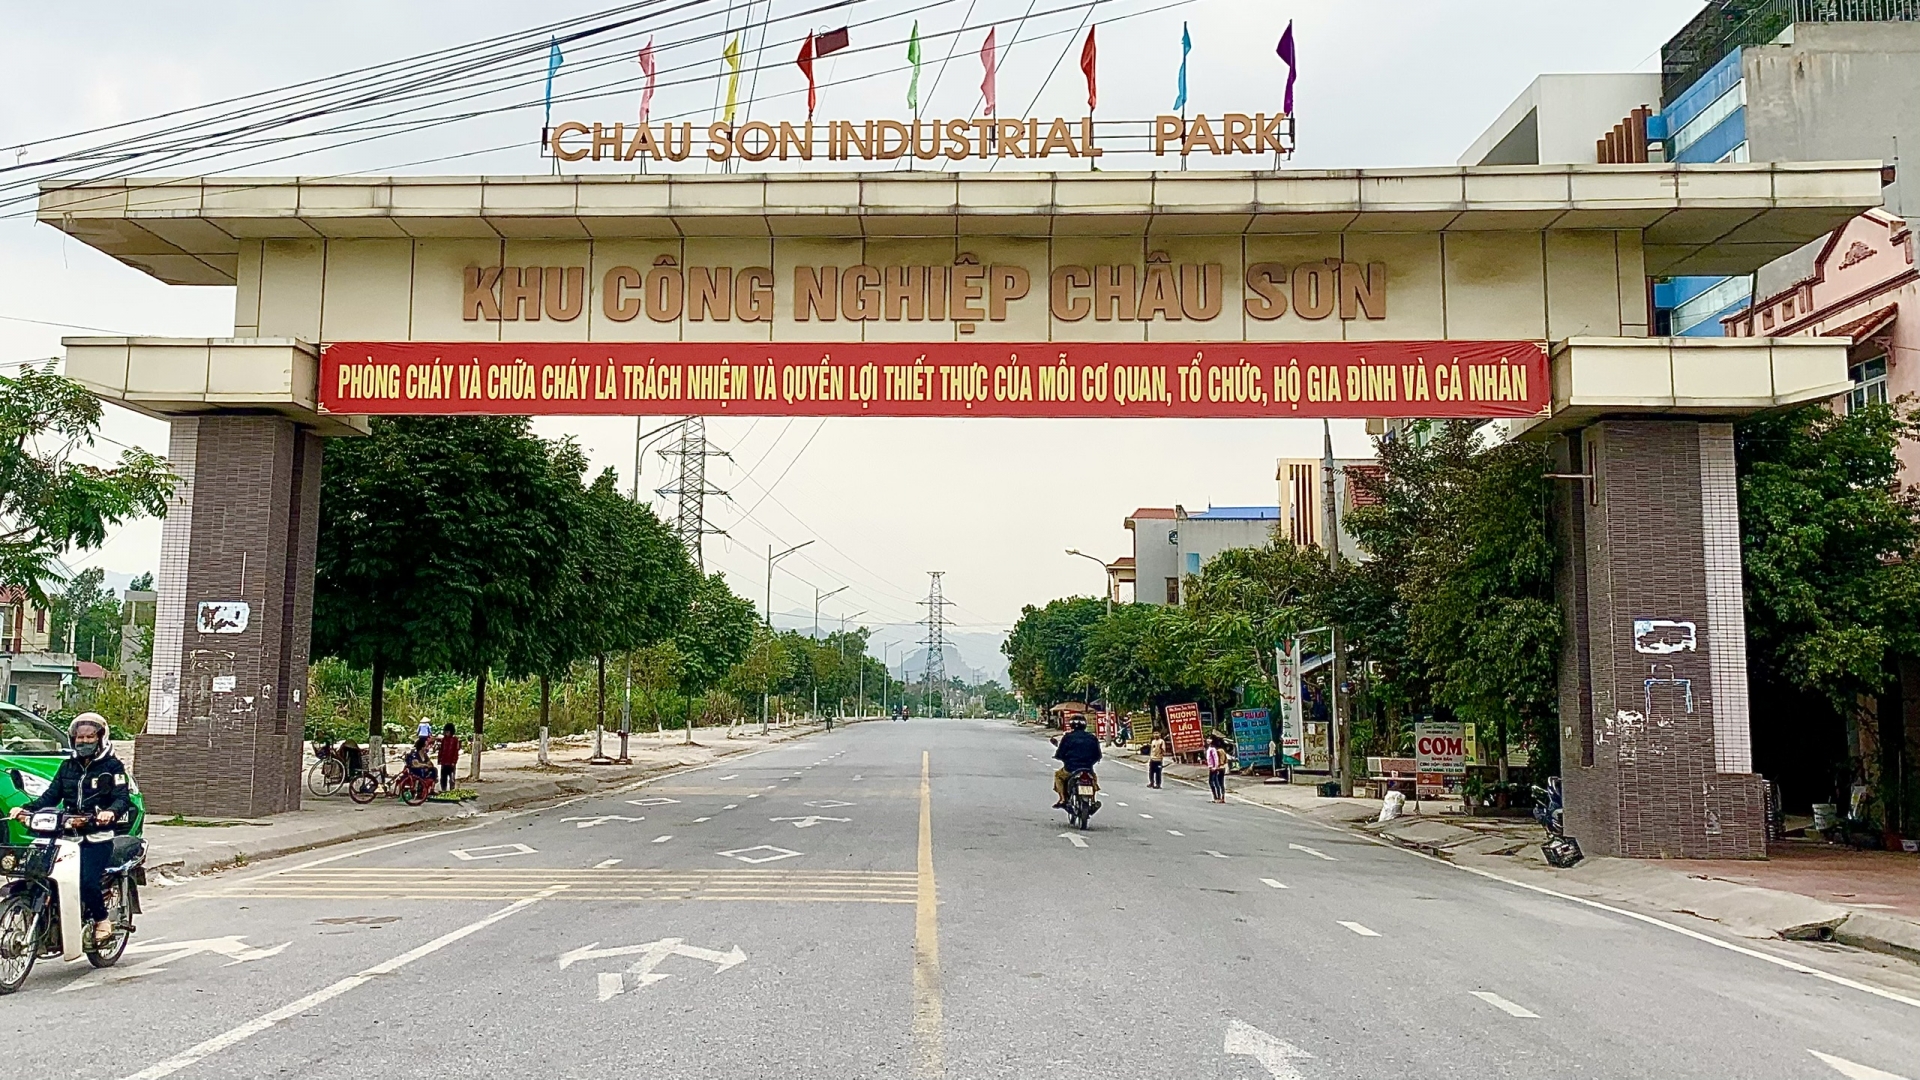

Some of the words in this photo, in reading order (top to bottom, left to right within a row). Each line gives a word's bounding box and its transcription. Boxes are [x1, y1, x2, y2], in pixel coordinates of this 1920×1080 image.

[551, 121, 692, 161] CHAU
[706, 120, 813, 161] SON
[829, 117, 1103, 160] INDUSTRIAL
[1155, 113, 1287, 157] PARK
[463, 266, 585, 321] KHU
[603, 254, 774, 322] CÔNG
[795, 253, 1031, 333] NGHIỆP
[1051, 251, 1223, 321] CHÂU
[1245, 257, 1387, 320] SƠN
[337, 356, 400, 399] PHÒNG
[405, 357, 454, 400] CHÁY
[458, 358, 481, 399] VÀ
[487, 358, 536, 400] CHỮA
[541, 357, 590, 400] CHÁY
[595, 358, 617, 400] LÀ
[622, 358, 682, 400] TRÁCH
[687, 358, 748, 407] NHIỆM
[754, 358, 777, 400] VÀ
[782, 354, 844, 404] QUYỀN
[849, 363, 878, 409] LỢI
[884, 354, 934, 401] THIẾT
[940, 363, 988, 409] THỰC
[994, 354, 1033, 402] CỦA
[1039, 353, 1076, 402] MỖI
[1082, 363, 1109, 402] CƠ
[1114, 364, 1172, 407] QUAN,
[1178, 352, 1203, 402] TỔ
[1208, 358, 1268, 407] CHỨC,
[1274, 358, 1301, 410] HỘ
[1307, 365, 1342, 402] GIA
[1347, 358, 1397, 402] ĐÌNH
[1402, 357, 1430, 401] VÀ
[1435, 357, 1464, 401] CÁ
[1469, 357, 1528, 402] NHÂN
[1418, 735, 1463, 756] CƠM
